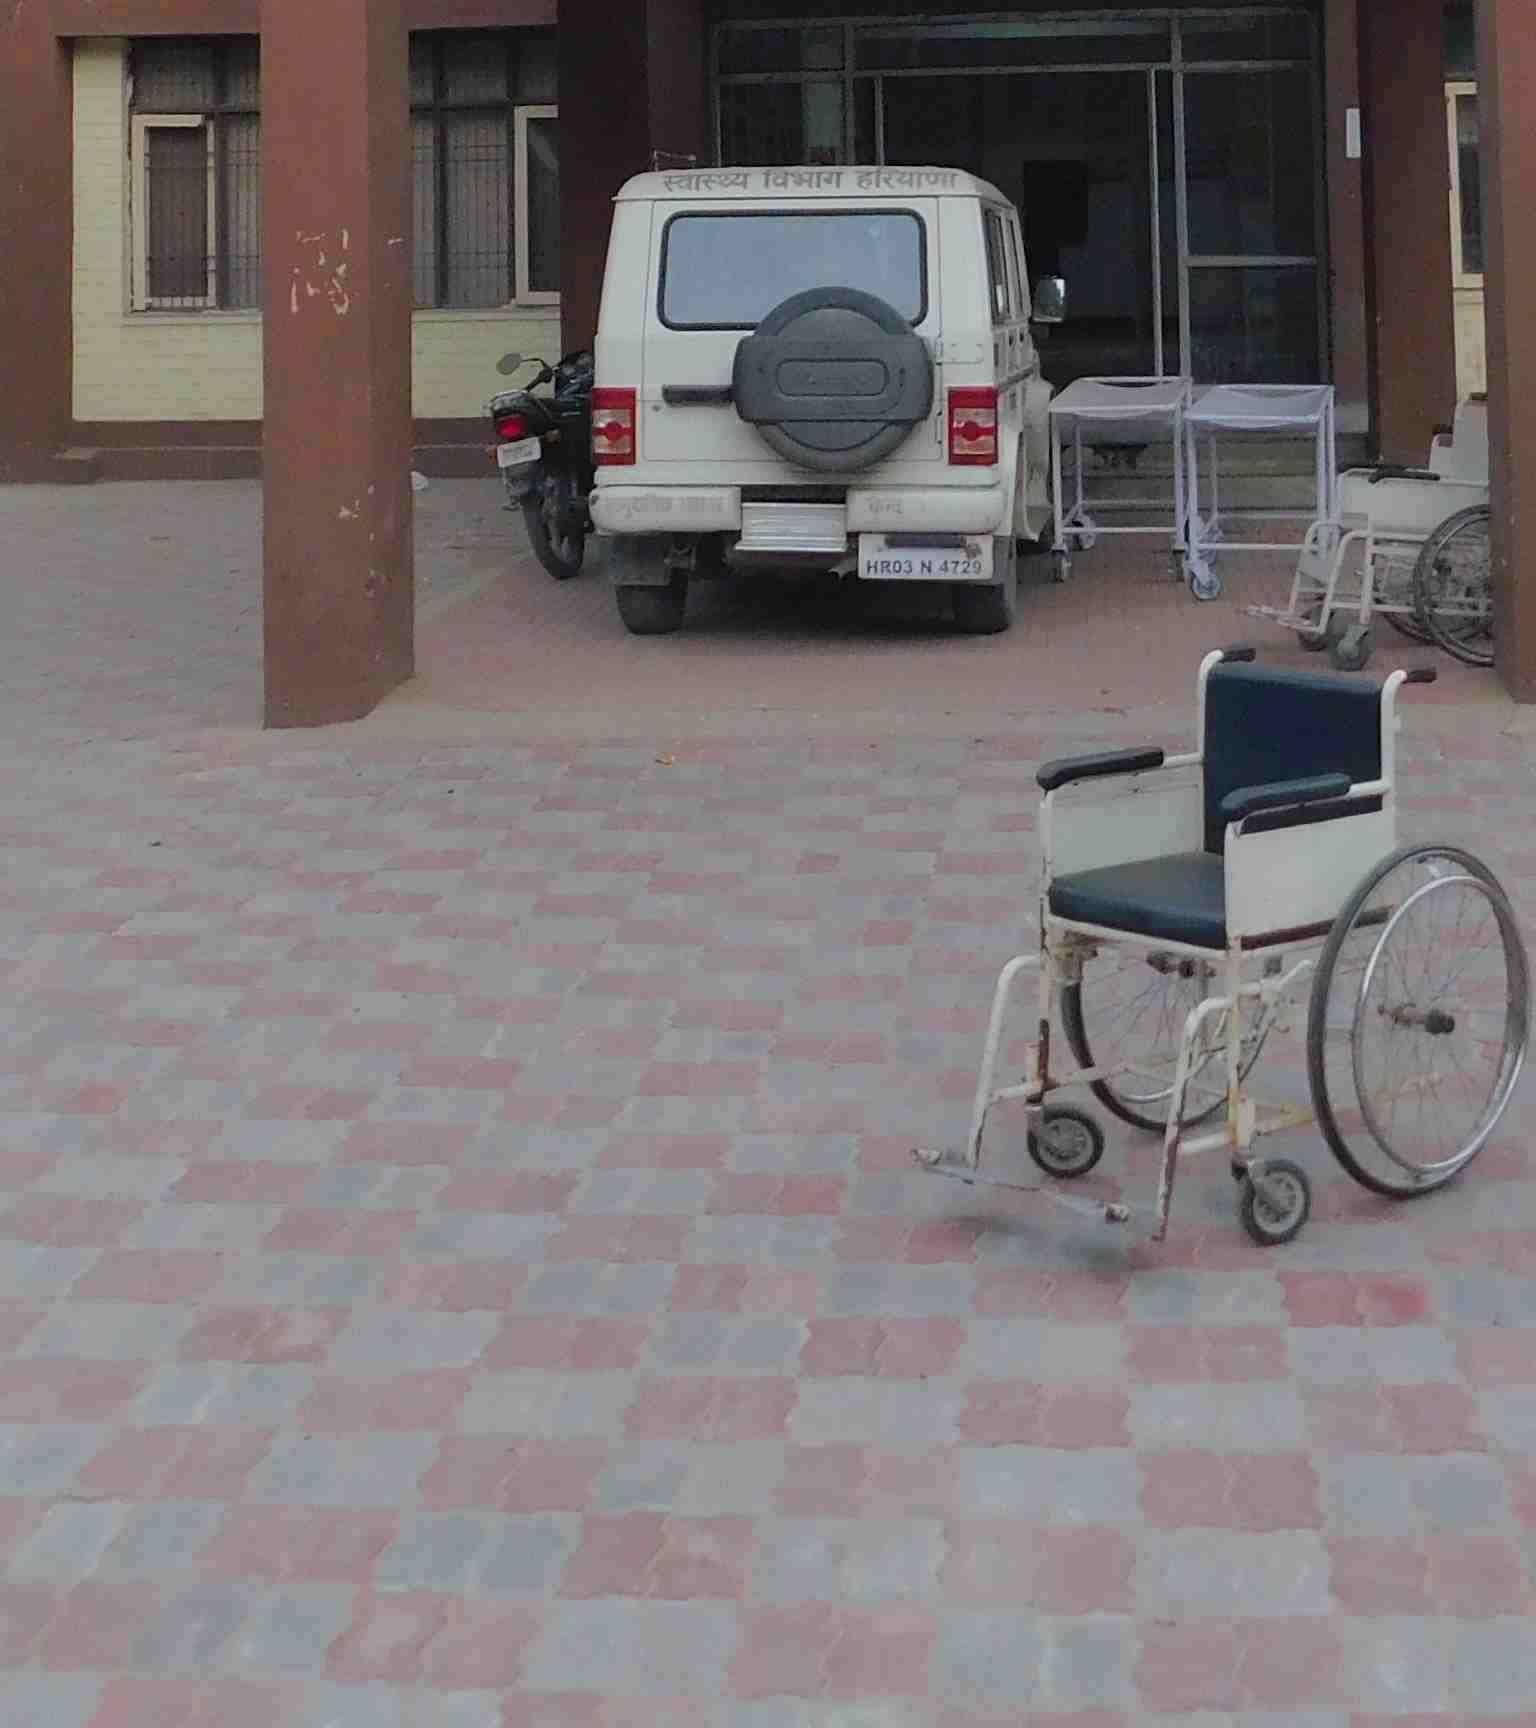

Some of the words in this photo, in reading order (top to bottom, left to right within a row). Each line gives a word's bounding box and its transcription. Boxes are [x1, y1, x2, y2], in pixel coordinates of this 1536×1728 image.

[663, 171, 748, 193] स्वास्थ्य
[763, 169, 842, 190] विभाग
[856, 168, 960, 190] हरियाणा
[866, 559, 913, 574] HR03
[920, 559, 932, 575] N
